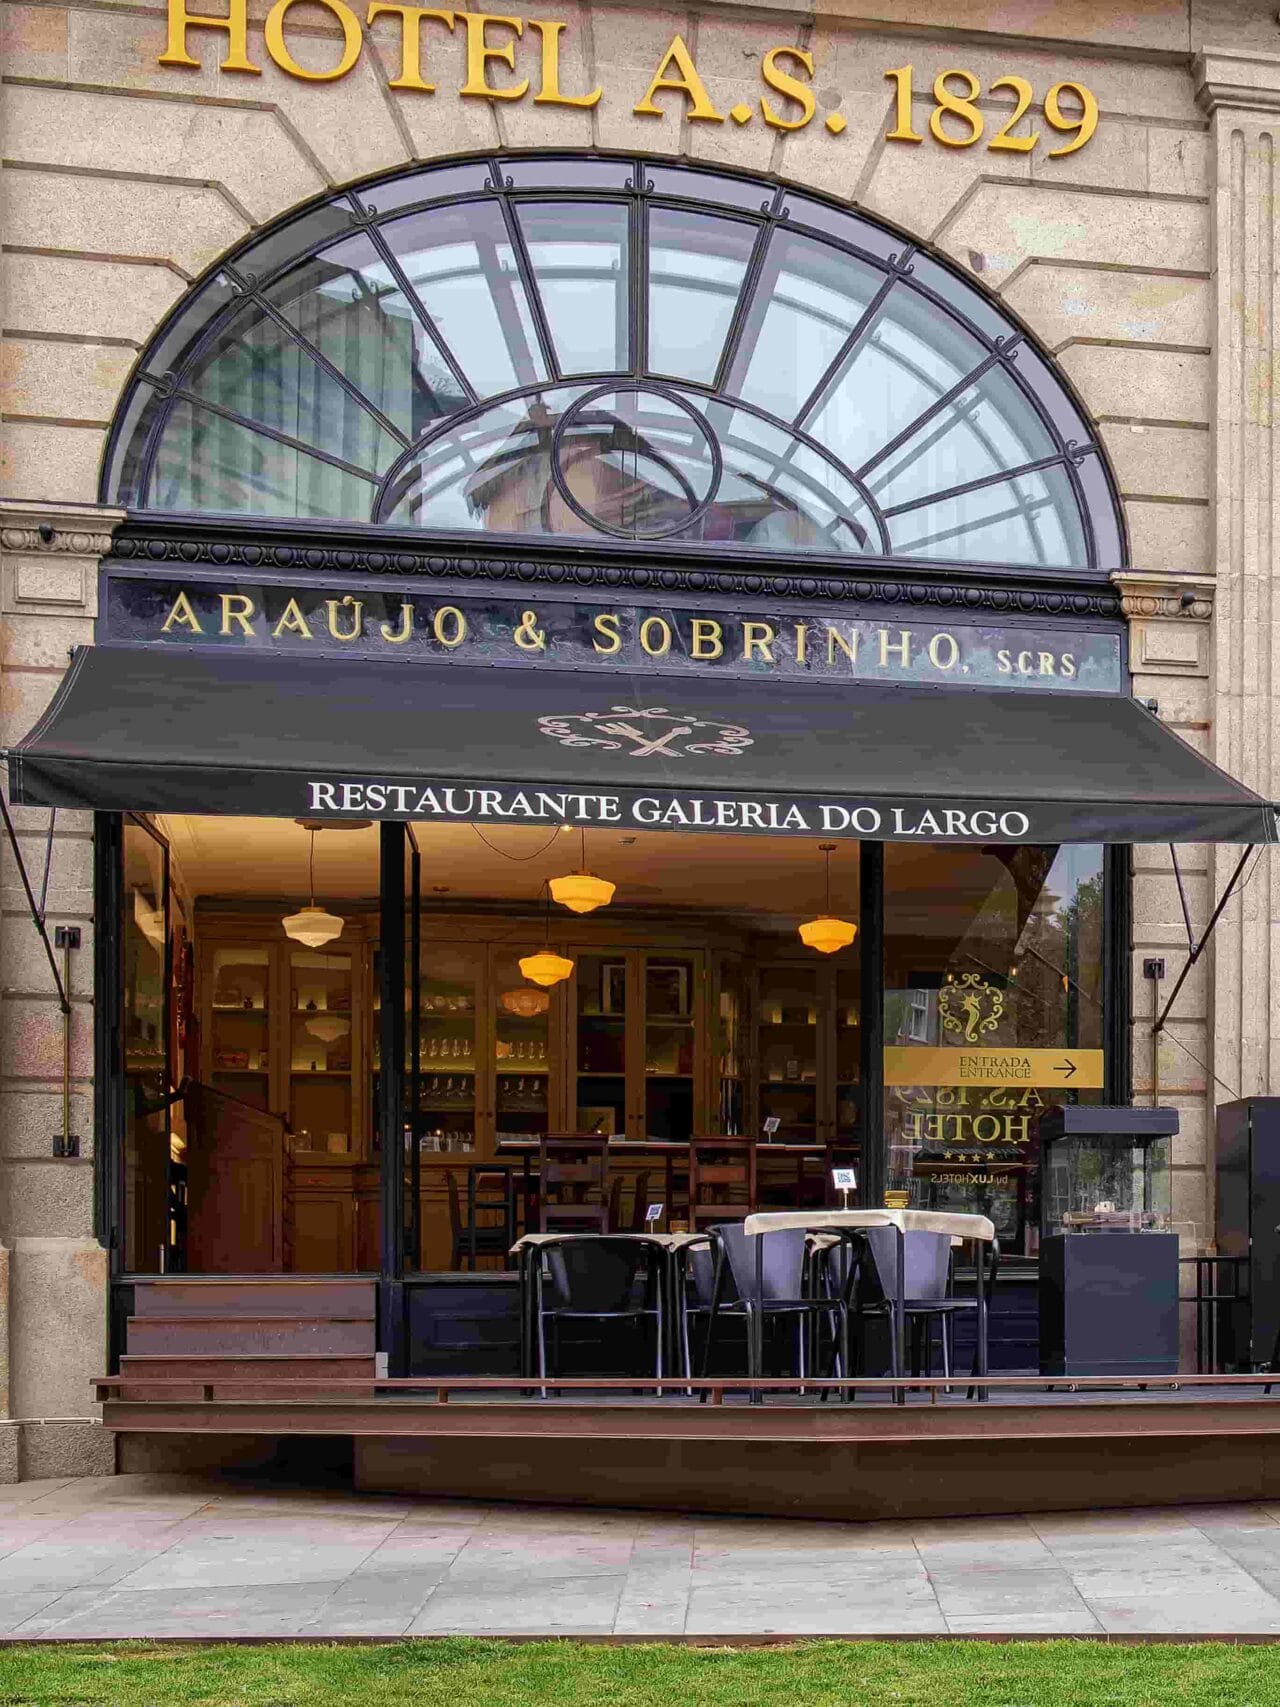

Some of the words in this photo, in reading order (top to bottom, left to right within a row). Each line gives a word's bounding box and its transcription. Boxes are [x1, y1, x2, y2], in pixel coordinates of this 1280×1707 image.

[158, 0, 603, 106] HOTEL
[635, 35, 847, 133] A.S.
[884, 65, 1099, 156] 1829
[162, 592, 466, 646] ARAÚJO
[513, 610, 546, 651] &
[997, 649, 1077, 678] SCRS
[307, 782, 621, 821] RESTAURANTE
[631, 796, 811, 830] GALERIA
[819, 805, 881, 833] DO
[890, 808, 1030, 838] LARGO
[959, 1056, 1031, 1068] ENTRADA
[959, 1067, 1032, 1079] ENTRANCE
